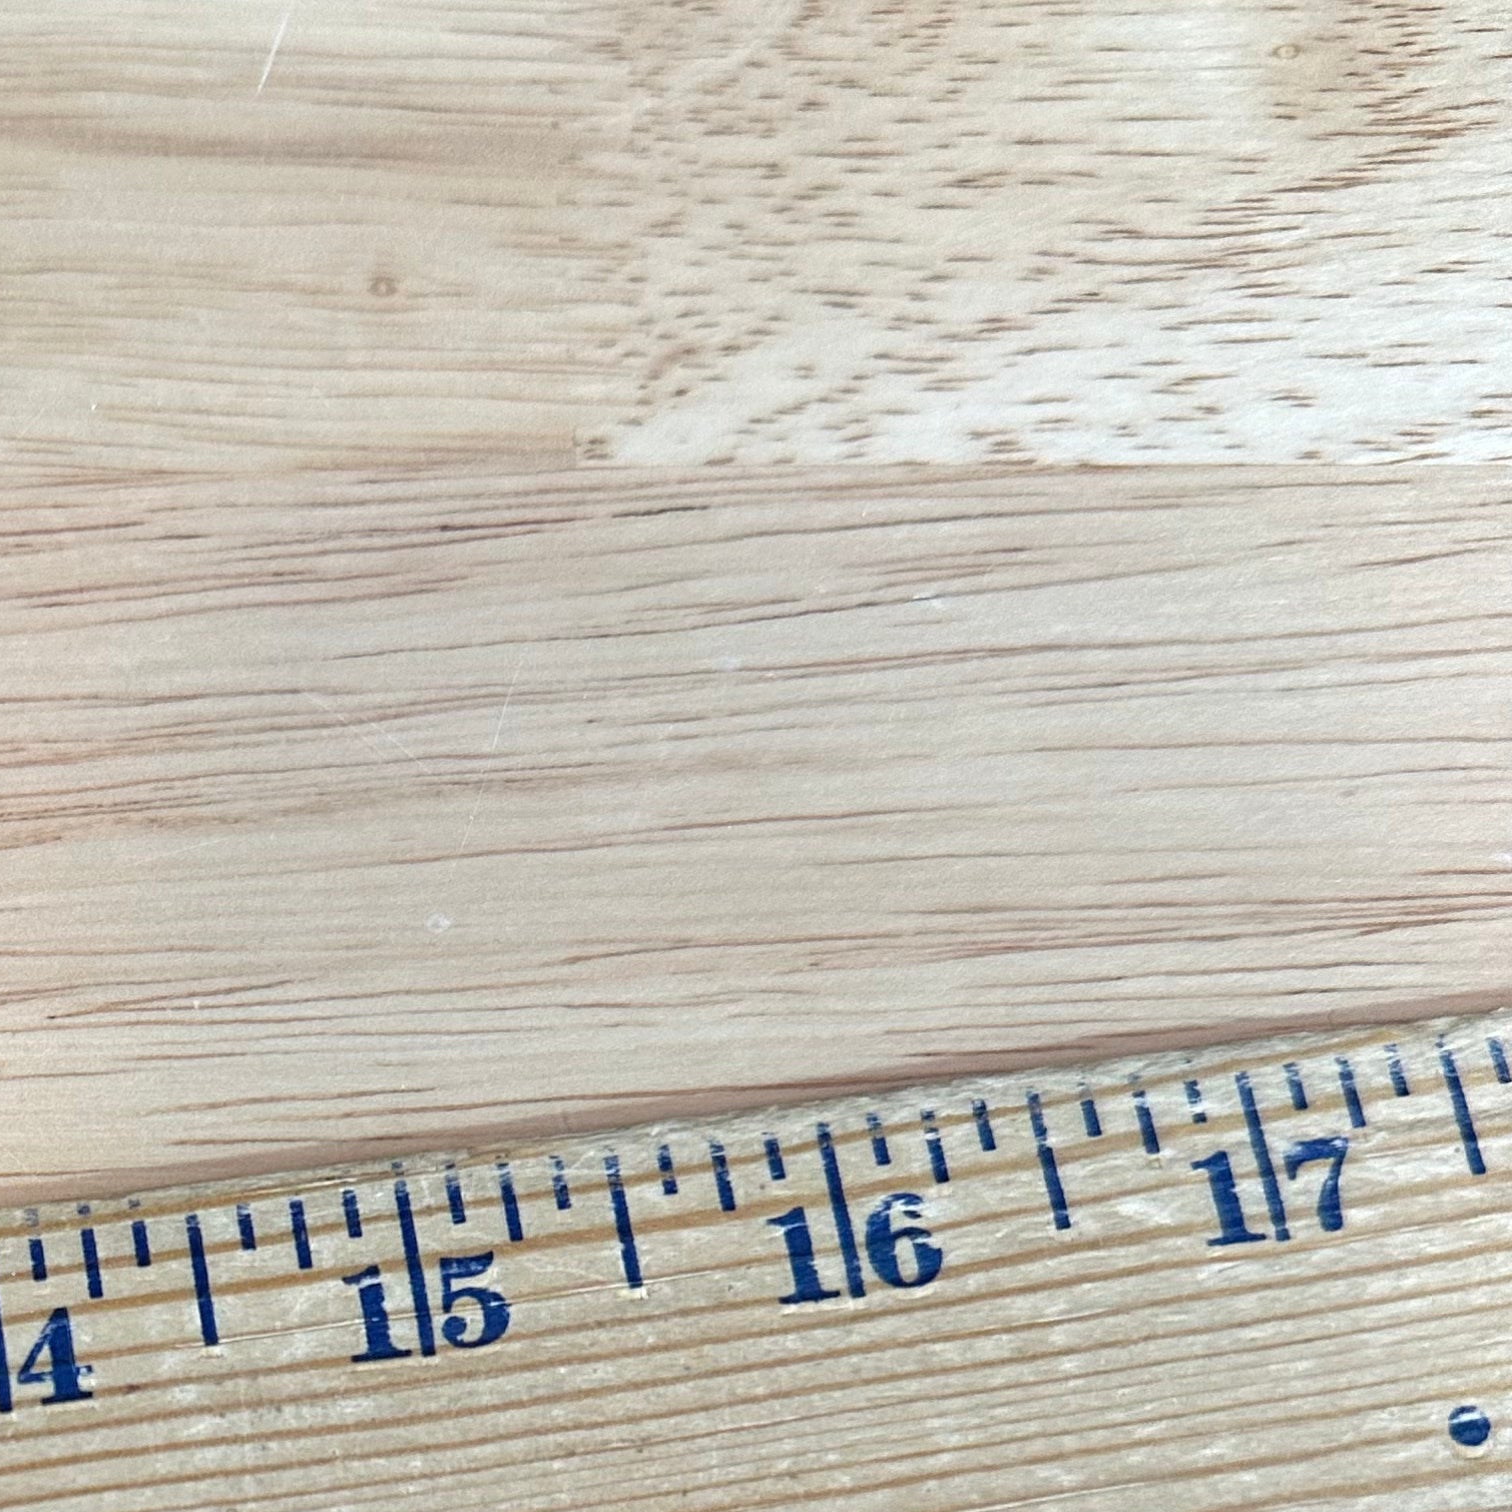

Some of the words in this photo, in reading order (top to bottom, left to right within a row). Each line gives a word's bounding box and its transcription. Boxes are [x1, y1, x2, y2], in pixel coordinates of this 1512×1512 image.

[1190, 1134, 1351, 1247] 17
[764, 1191, 944, 1306] 16
[342, 1251, 512, 1363] 15
